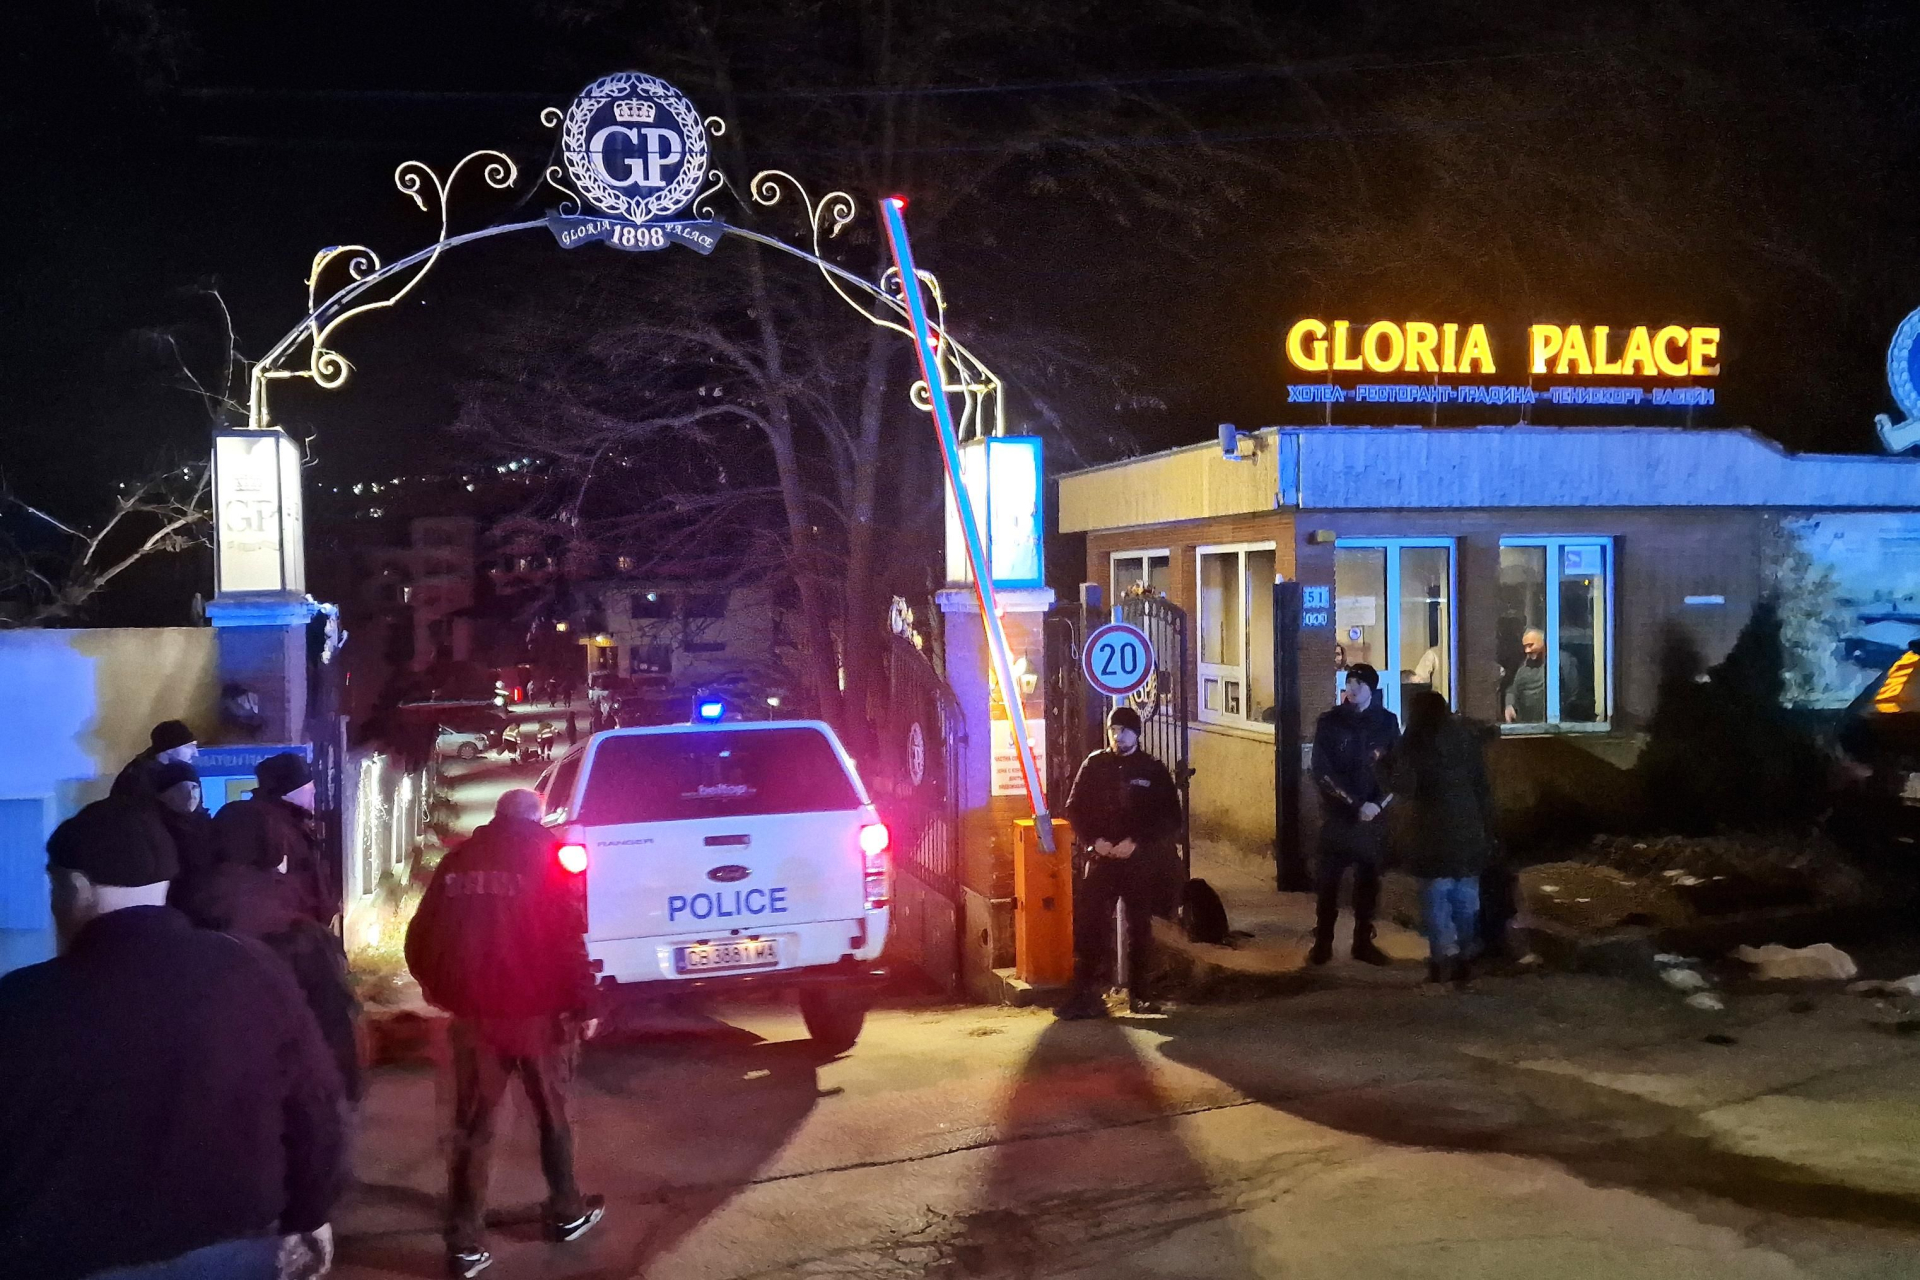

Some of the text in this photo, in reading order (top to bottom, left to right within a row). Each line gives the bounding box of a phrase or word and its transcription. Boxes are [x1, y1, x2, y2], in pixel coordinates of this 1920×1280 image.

[589, 125, 682, 187] GP
[561, 220, 611, 245] GLORIA
[610, 224, 665, 247] 1898
[664, 222, 714, 249] PALACE
[1285, 318, 1721, 376] GLORIA PALACE
[1287, 384, 1344, 402] ХОТЕЛ
[1308, 591, 1322, 603] 51
[1100, 642, 1137, 676] 20
[668, 887, 787, 921] POLICE
